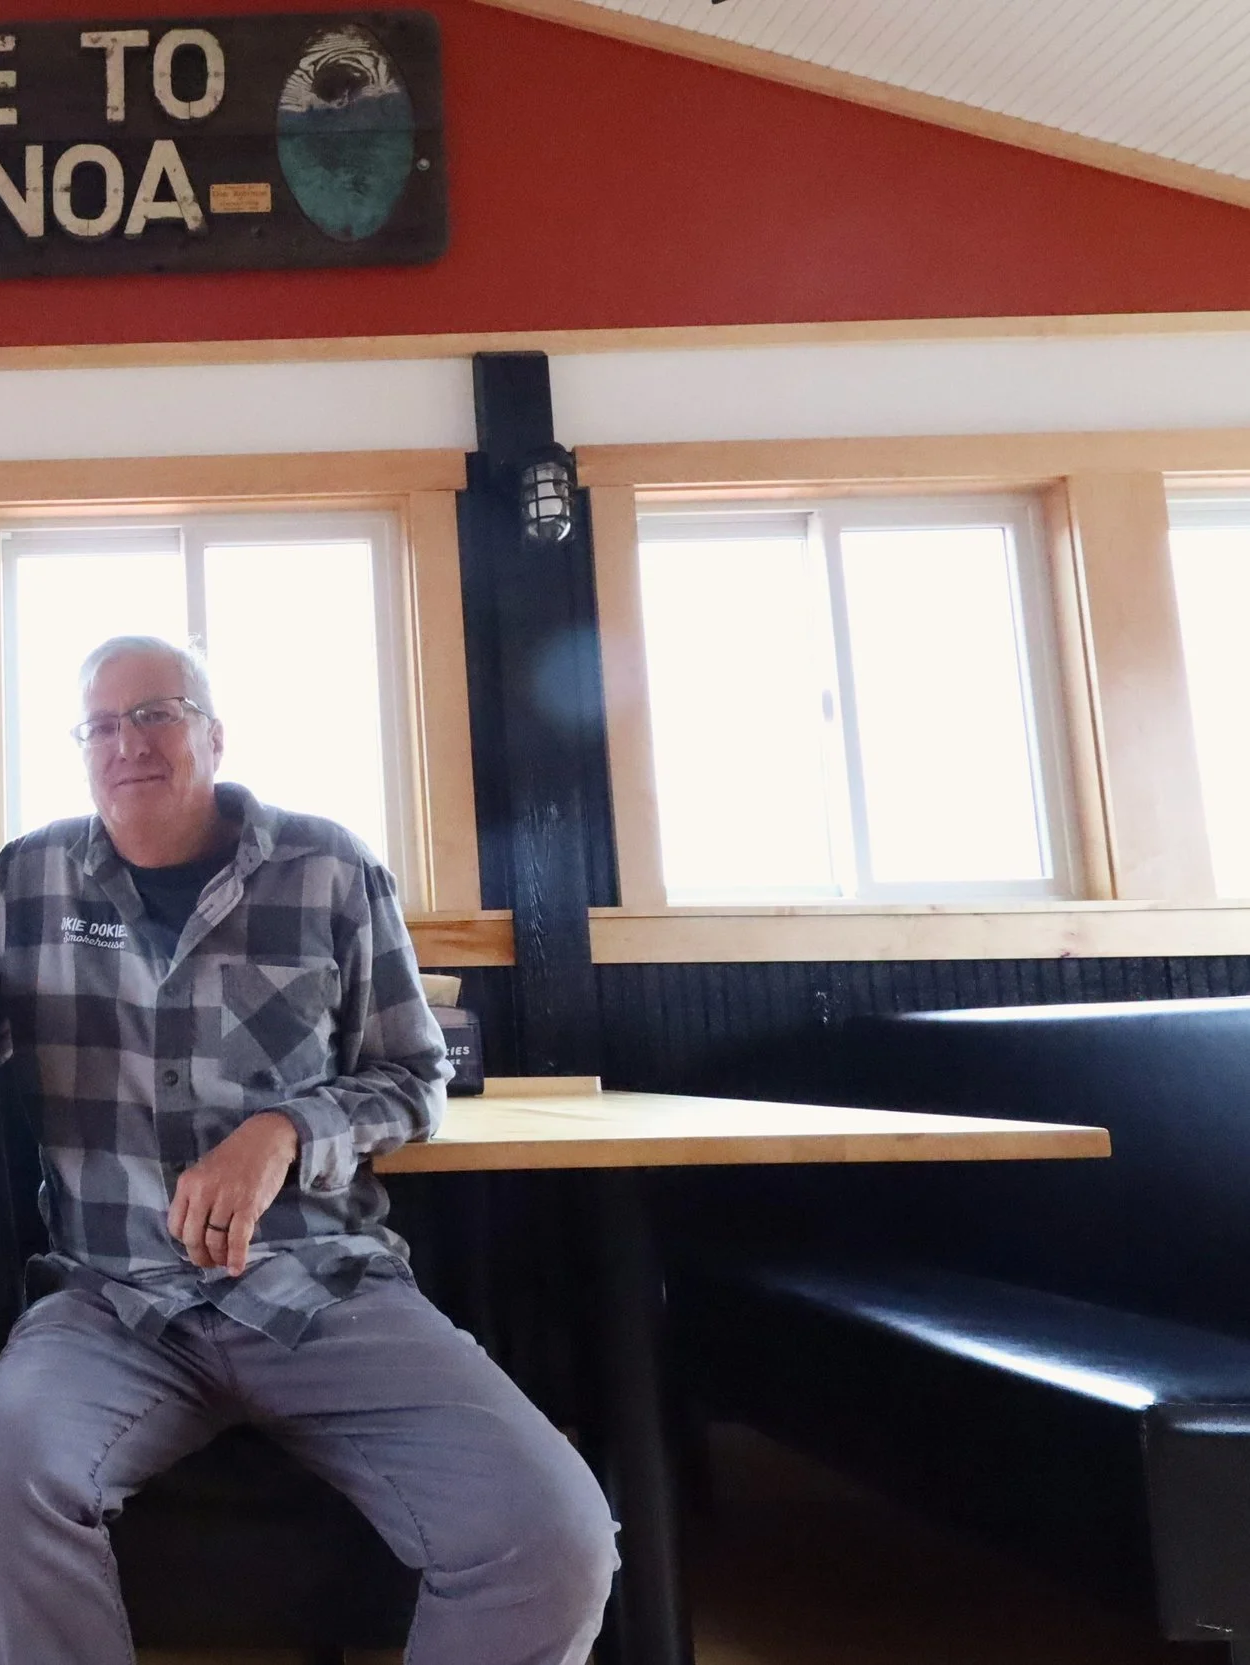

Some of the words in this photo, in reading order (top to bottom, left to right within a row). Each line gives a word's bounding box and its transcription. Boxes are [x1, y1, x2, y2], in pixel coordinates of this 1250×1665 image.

[81, 29, 227, 122] TO
[90, 923, 128, 938] DOKIE
[63, 931, 126, 949] Smokehouse
